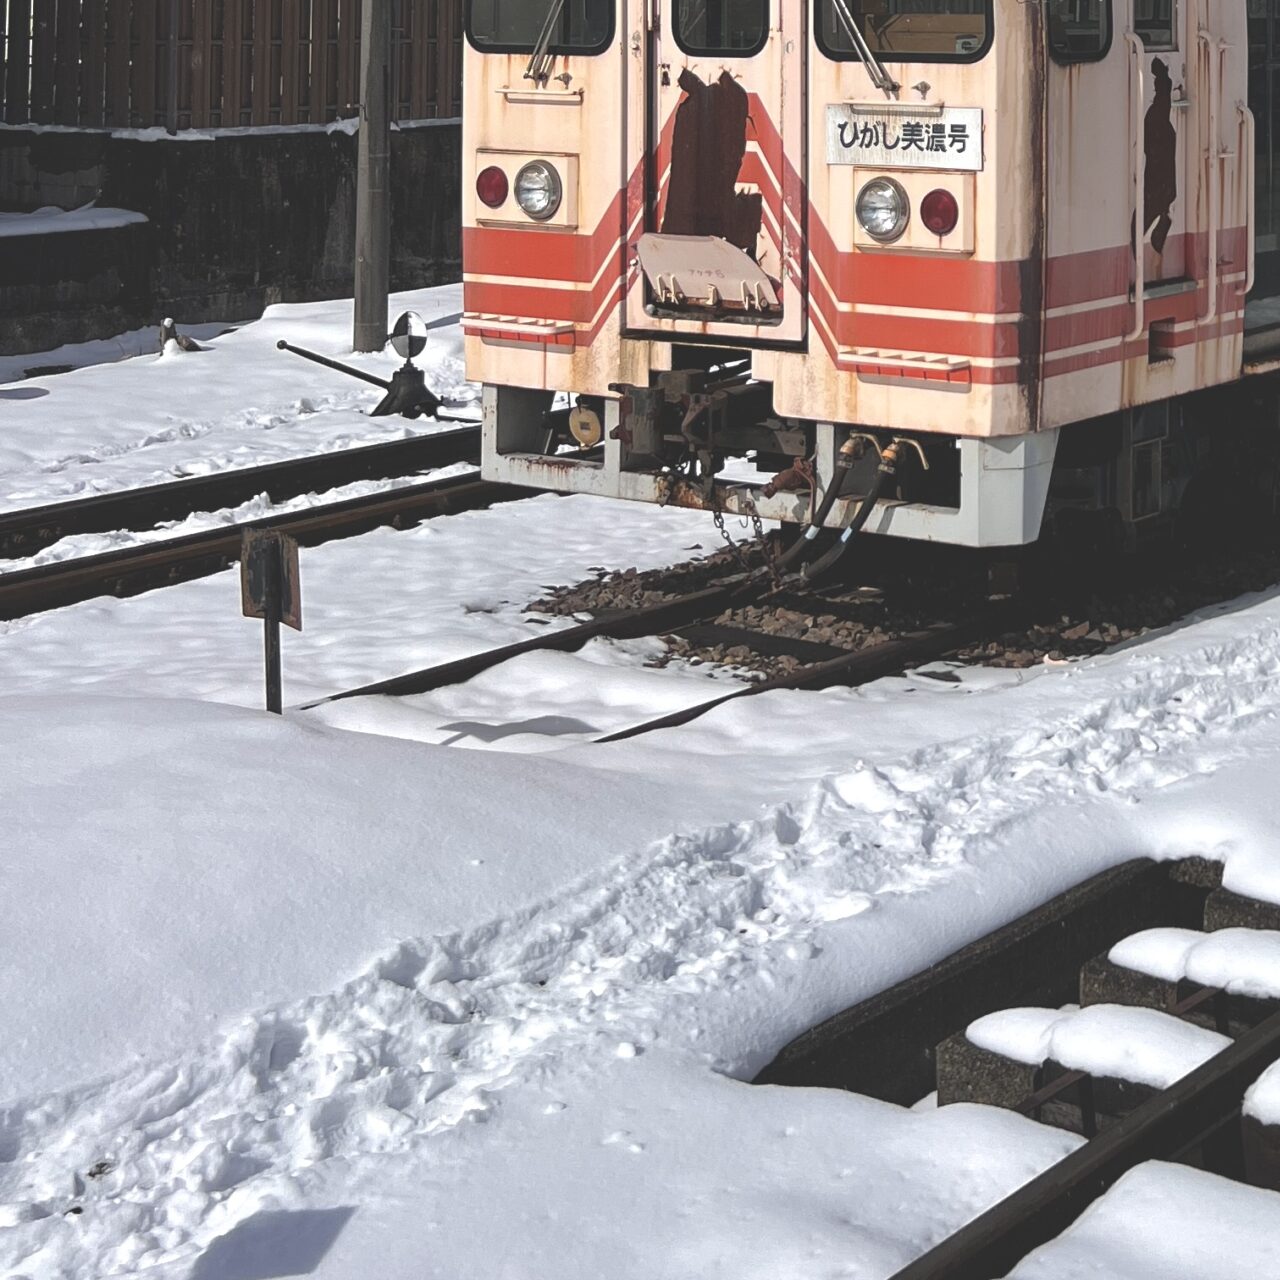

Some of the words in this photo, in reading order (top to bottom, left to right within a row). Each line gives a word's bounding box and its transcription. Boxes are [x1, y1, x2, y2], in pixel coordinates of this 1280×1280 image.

[837, 120, 970, 154] ひがし美濃号
